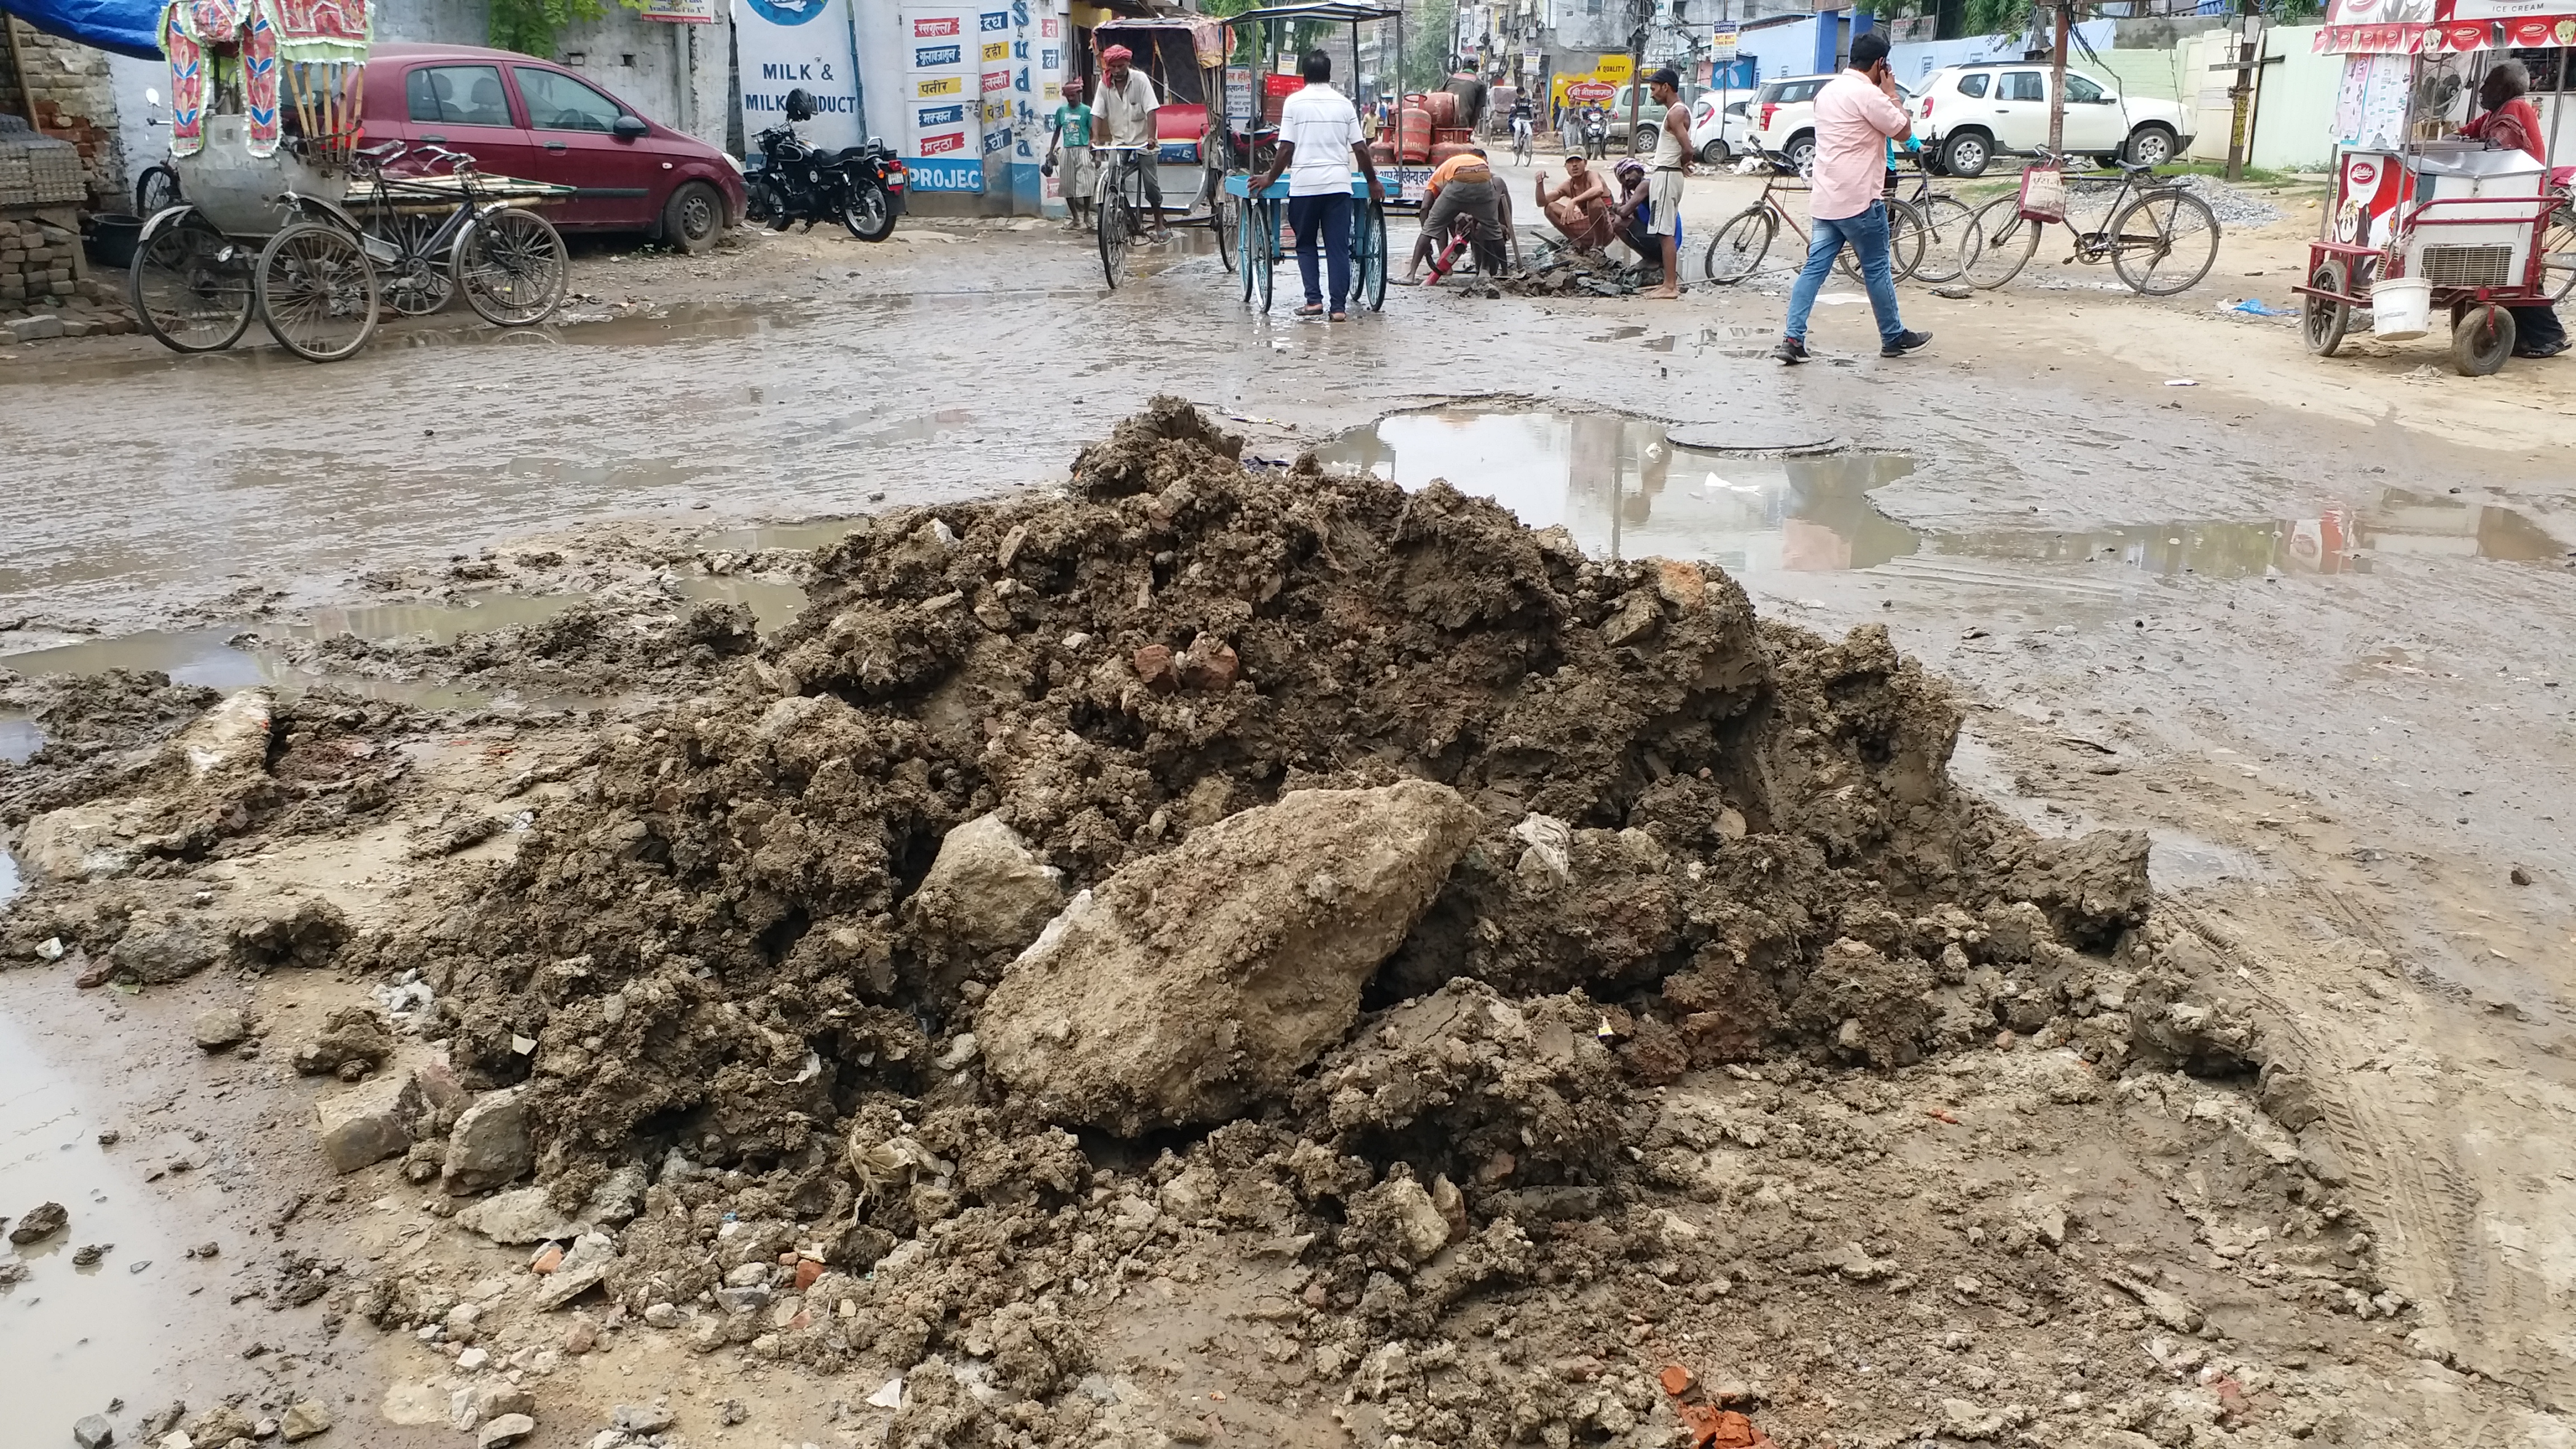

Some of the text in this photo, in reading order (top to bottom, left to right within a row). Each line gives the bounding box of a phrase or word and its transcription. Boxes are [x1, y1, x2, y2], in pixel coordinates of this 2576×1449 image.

[2512, 3, 2545, 12] CREAM
[917, 21, 952, 36] रसगुल्ला
[984, 15, 1002, 31] दूध
[985, 43, 1002, 59] दही
[763, 63, 834, 81] MILK &
[921, 79, 948, 94] पनीर
[745, 94, 787, 111] MILK
[923, 110, 951, 124] मक्खन
[988, 132, 1004, 150] घी
[910, 168, 983, 189] PROJEC
